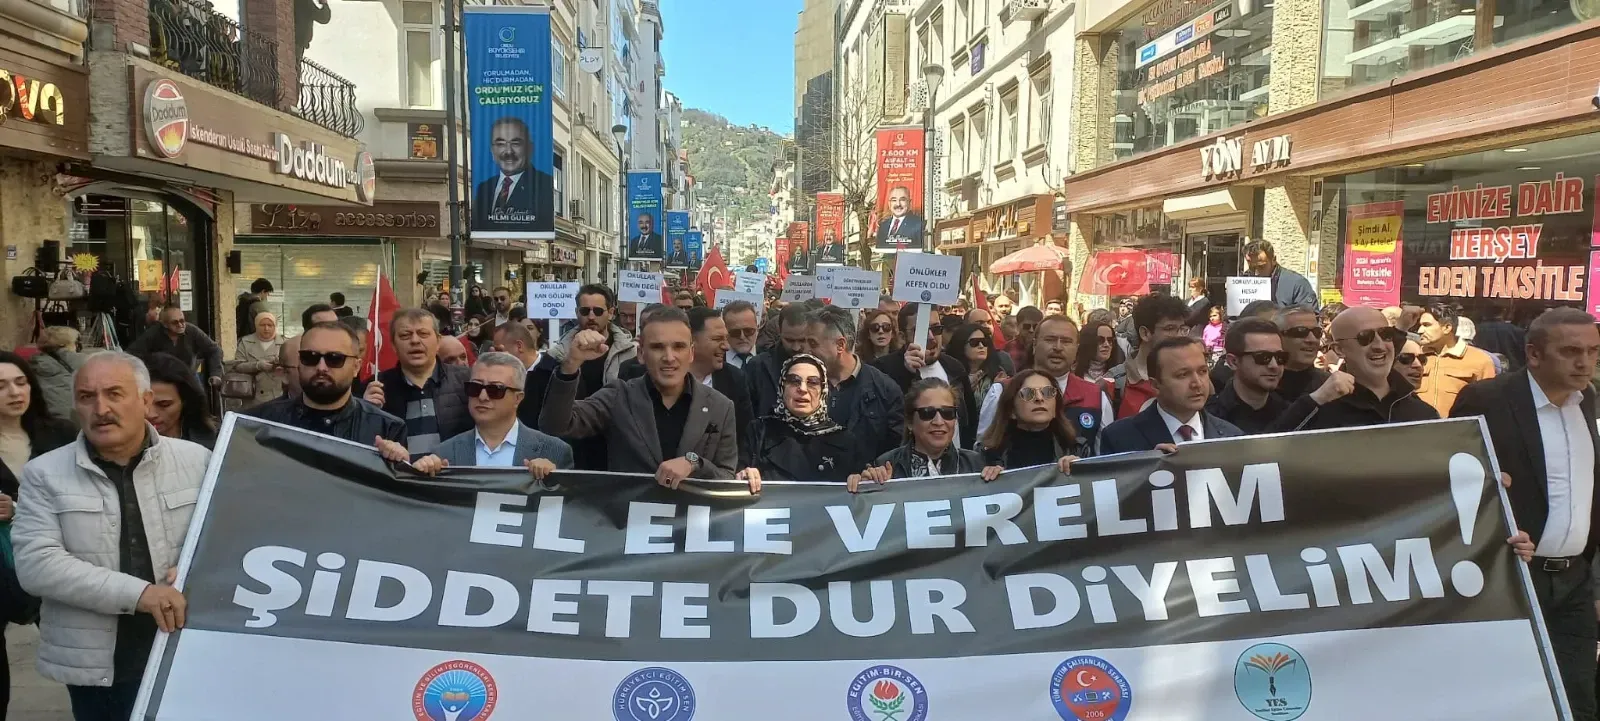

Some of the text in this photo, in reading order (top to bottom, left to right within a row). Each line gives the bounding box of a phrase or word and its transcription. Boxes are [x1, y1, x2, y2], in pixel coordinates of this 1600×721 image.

[479, 95, 540, 105] ÇALIŞIYORUZ
[280, 133, 347, 188] Daddum
[1200, 136, 1245, 178] YÖN
[1427, 171, 1584, 224] EVİNİZE DAİR
[334, 211, 437, 228] accessories
[1358, 224, 1380, 236] Şimdi
[1450, 223, 1544, 264] HERŞEY
[627, 272, 656, 281] OKULLAR
[909, 266, 947, 277] ÖNLÜKLER
[1353, 267, 1392, 277] 12 Taksitle
[622, 281, 660, 291] TEKİN DEĞİL
[905, 280, 950, 290] KEFEN OLDU
[1418, 259, 1585, 301] ELDEN TAKSİTLE
[469, 491, 585, 554] EL
[624, 501, 793, 555] ELE
[749, 578, 976, 639] DUR
[682, 695, 690, 712] SEN
[1265, 698, 1288, 707] YES
[1085, 710, 1105, 719] 2006
